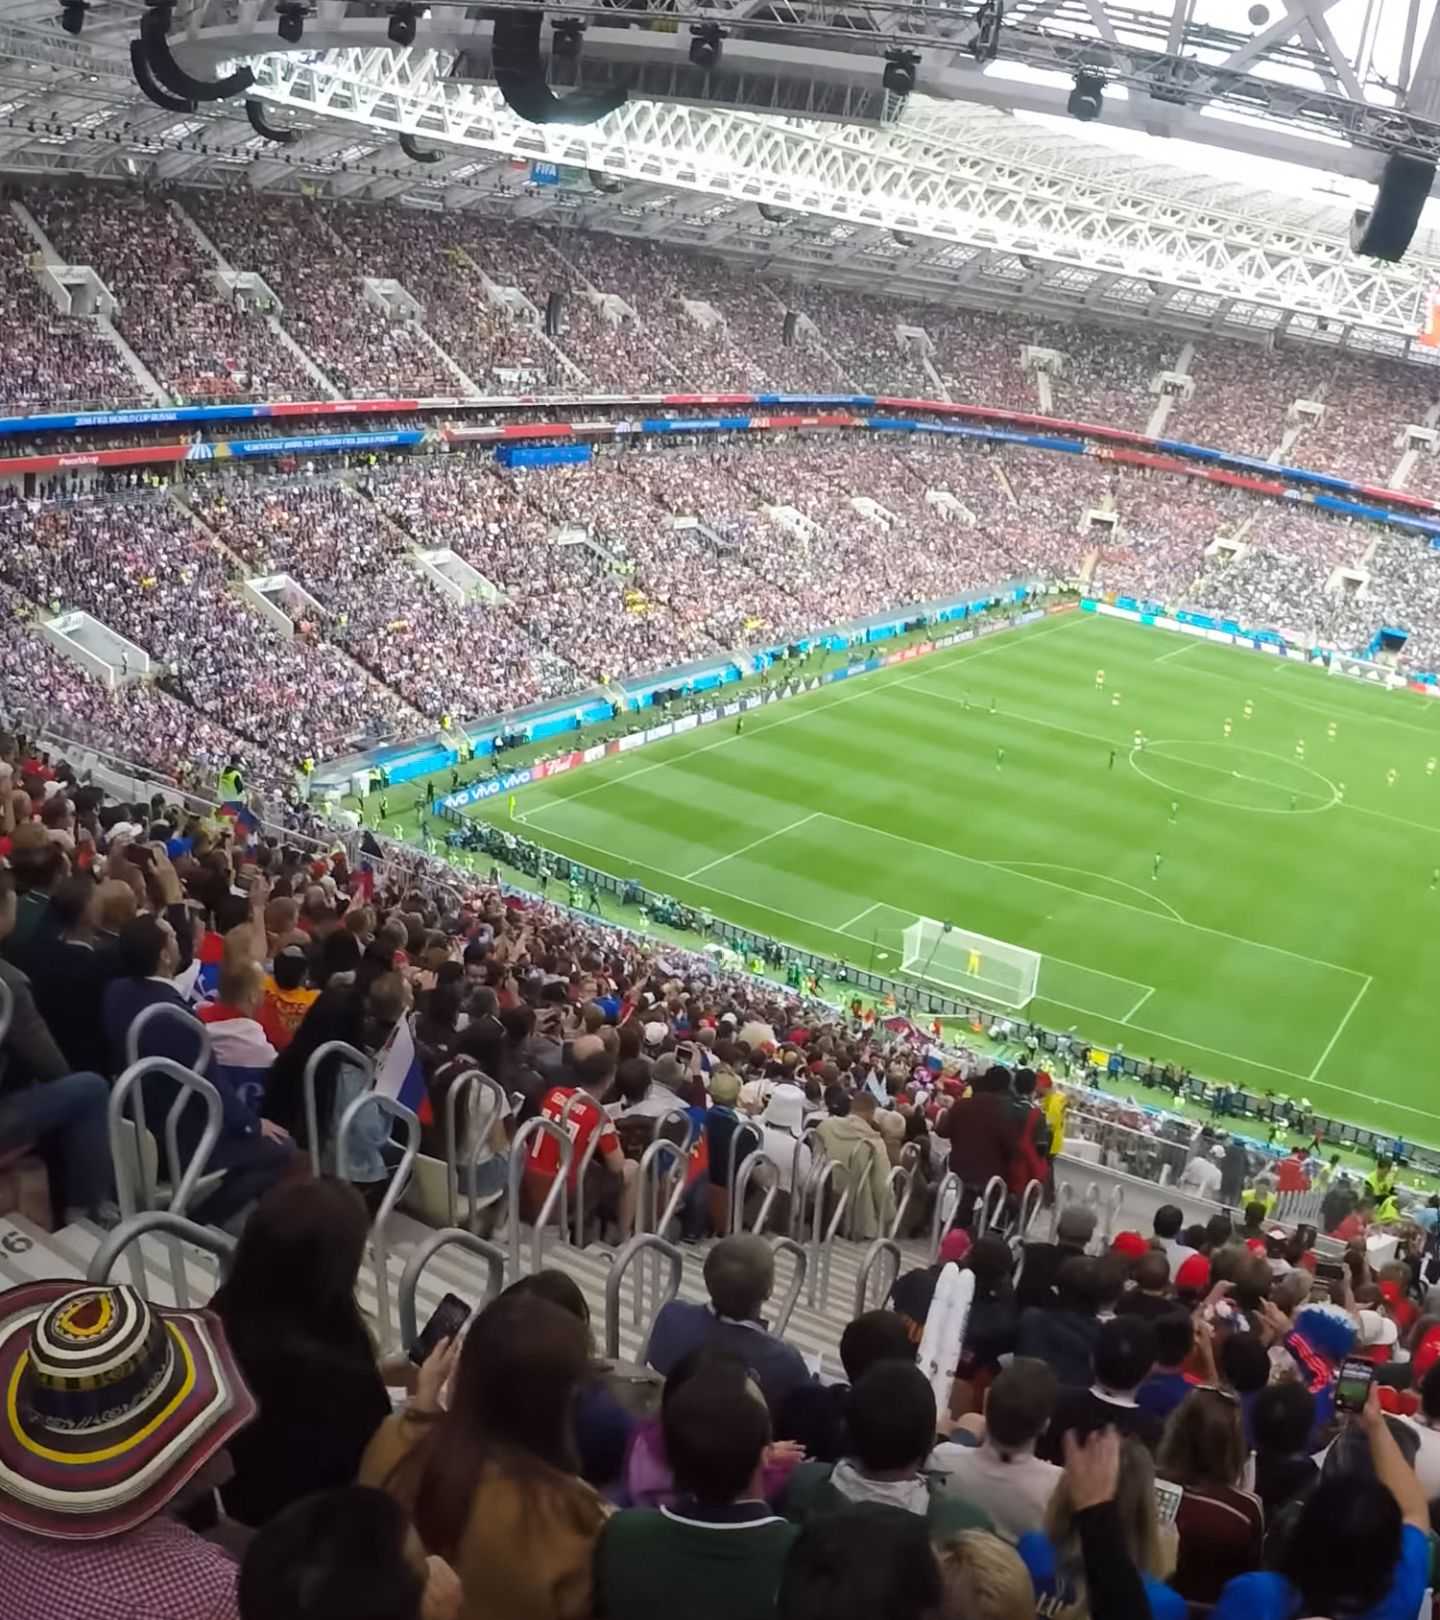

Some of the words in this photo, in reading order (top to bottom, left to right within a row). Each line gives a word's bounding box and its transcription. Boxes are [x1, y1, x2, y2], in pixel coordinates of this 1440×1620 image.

[535, 162, 556, 176] FIFA
[472, 781, 500, 799] vivo
[503, 771, 530, 789] vivo
